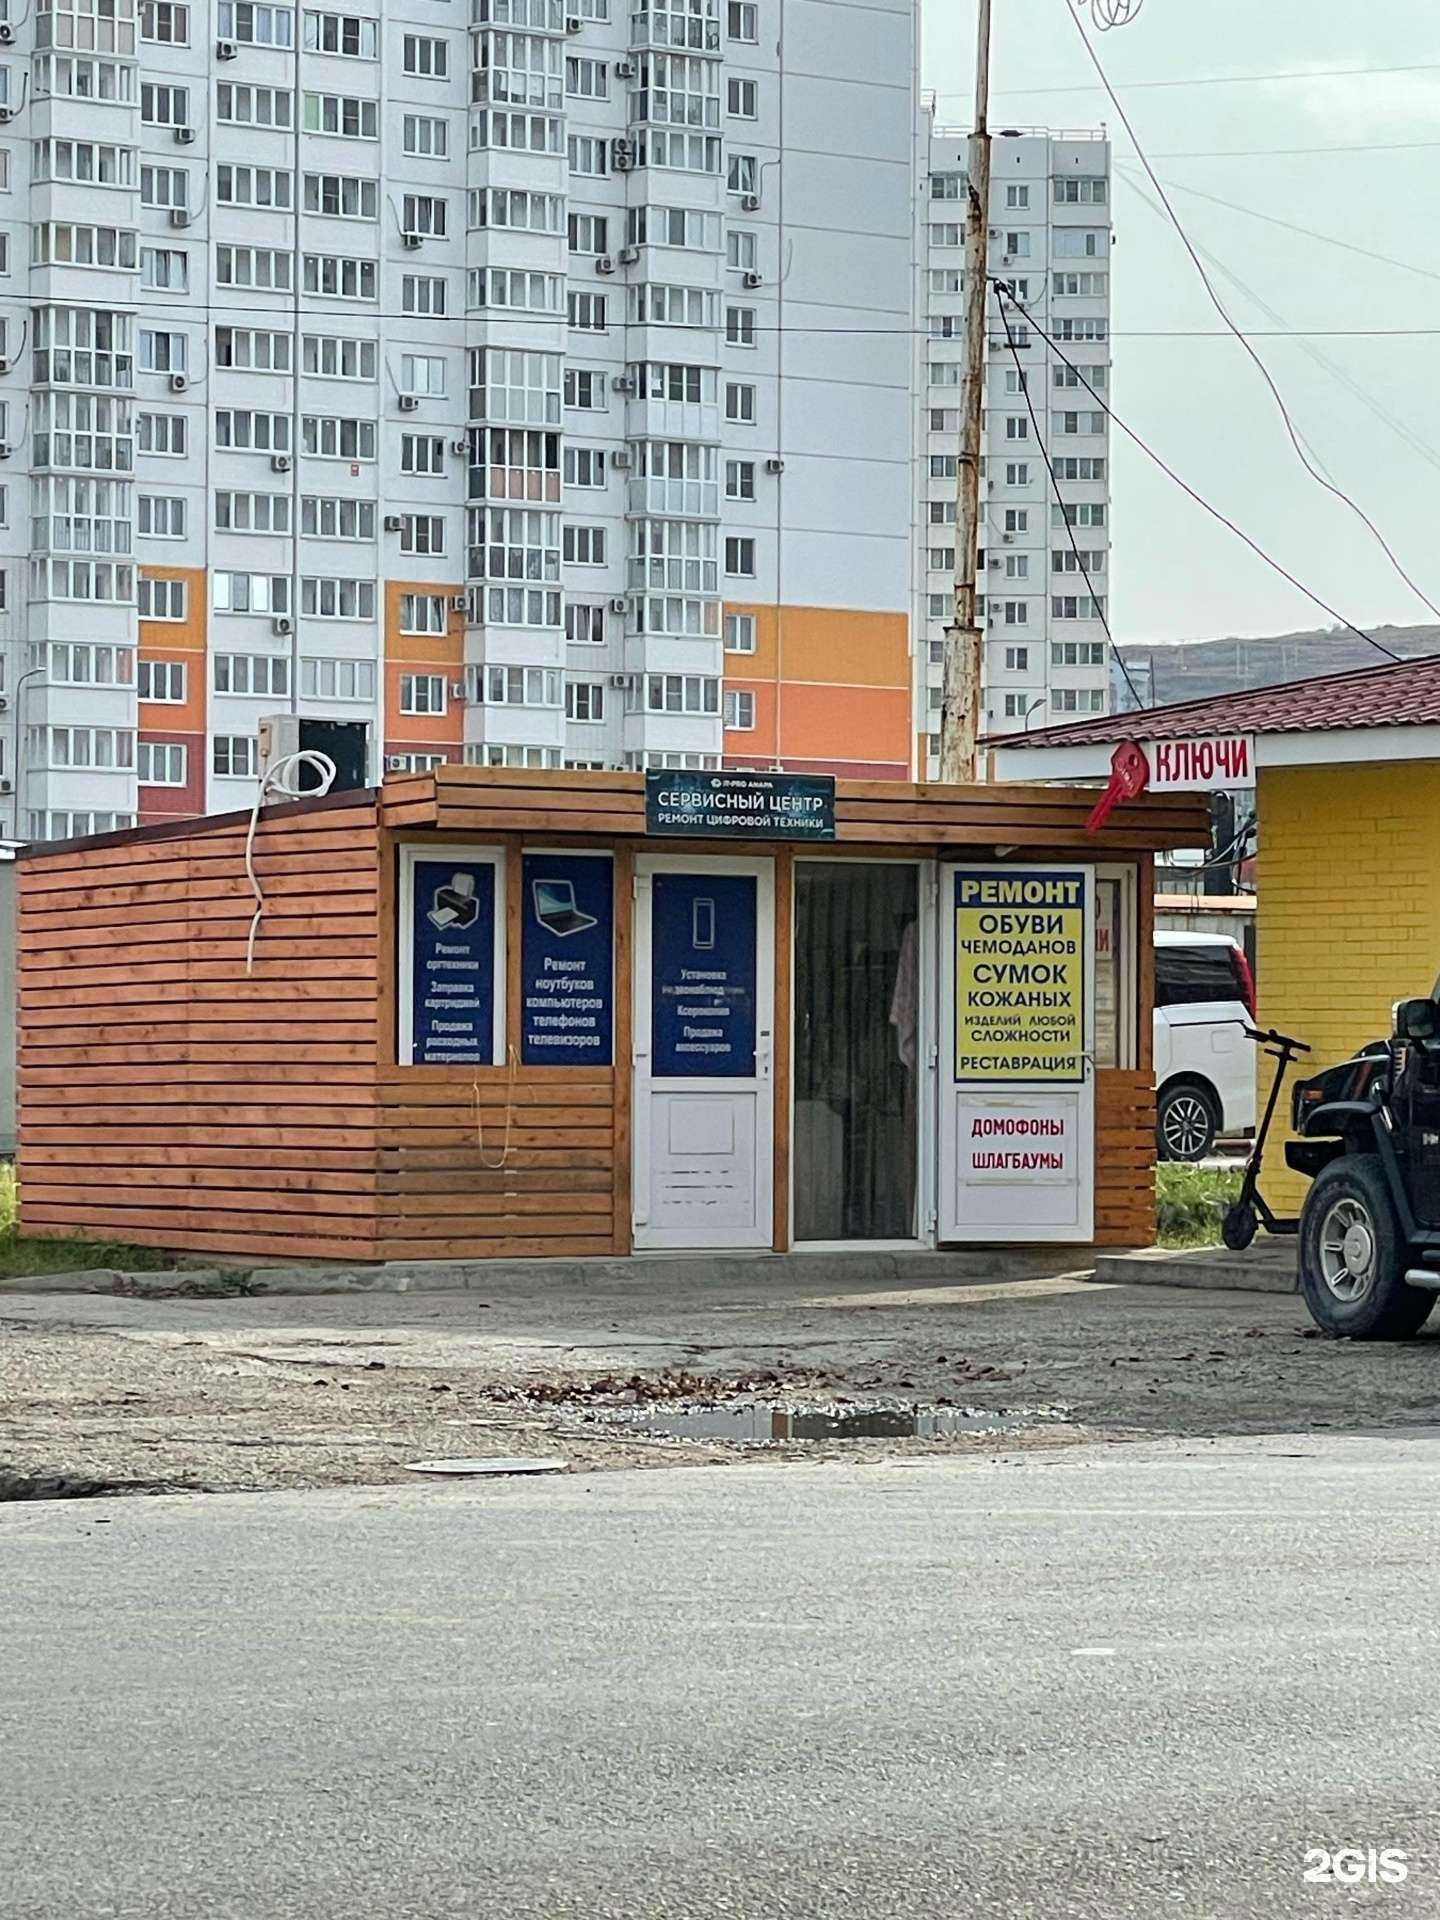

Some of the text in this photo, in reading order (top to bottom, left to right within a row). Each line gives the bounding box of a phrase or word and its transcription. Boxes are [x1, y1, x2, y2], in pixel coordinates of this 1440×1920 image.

[1156, 739, 1248, 782] КЛЮЧИ
[658, 791, 823, 812] СЕРВИСНЫЙ ЦЕНТР
[658, 812, 824, 829] РЕМОНТ ЦИФРОВОЙ ТЕХНИКИ
[961, 880, 1080, 904] РЕМОНТ
[979, 915, 1063, 934] ОБУВИ
[961, 940, 1076, 956] ЧЕМОДАНОВ
[544, 957, 586, 971] Ремонт
[973, 964, 1067, 984] СУМОК
[535, 976, 594, 993] ноутбуков
[526, 997, 603, 1011] компьютеров
[968, 991, 1071, 1007] КОЖАНЫХ
[533, 1013, 596, 1029] телефонов
[964, 1014, 1075, 1026] ИЗДЕЛИЙ ЛЮБОЙ
[527, 1035, 601, 1048] телевизоров
[971, 1029, 1070, 1042] СЛОЖНОСТИ
[961, 1056, 1076, 1071] РЕСТАВРАЦИЯ
[971, 1119, 1064, 1138] ДОМОФОНЫ
[972, 1153, 1063, 1169] ШЛАГБАУМЫ
